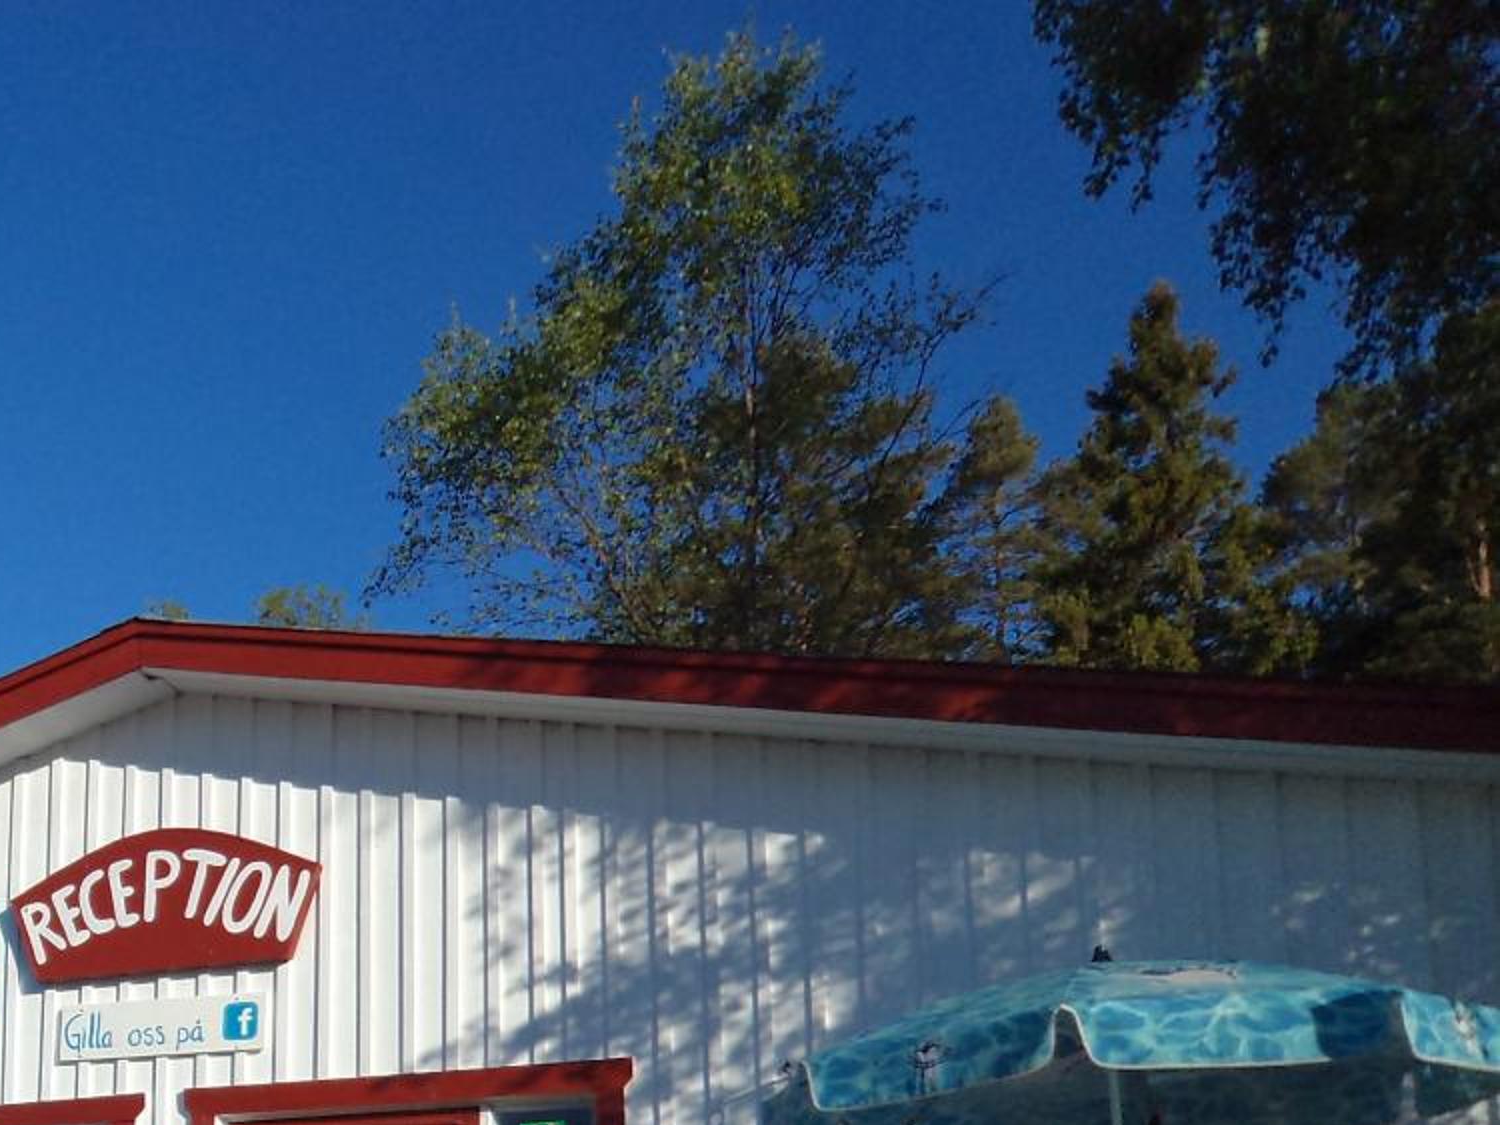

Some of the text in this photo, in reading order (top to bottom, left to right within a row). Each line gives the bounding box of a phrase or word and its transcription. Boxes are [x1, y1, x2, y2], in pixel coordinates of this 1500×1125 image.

[21, 848, 310, 966] RECEPTION
[63, 1008, 113, 1051] Gilla
[127, 1024, 166, 1047] oss
[175, 1019, 205, 1051] på
